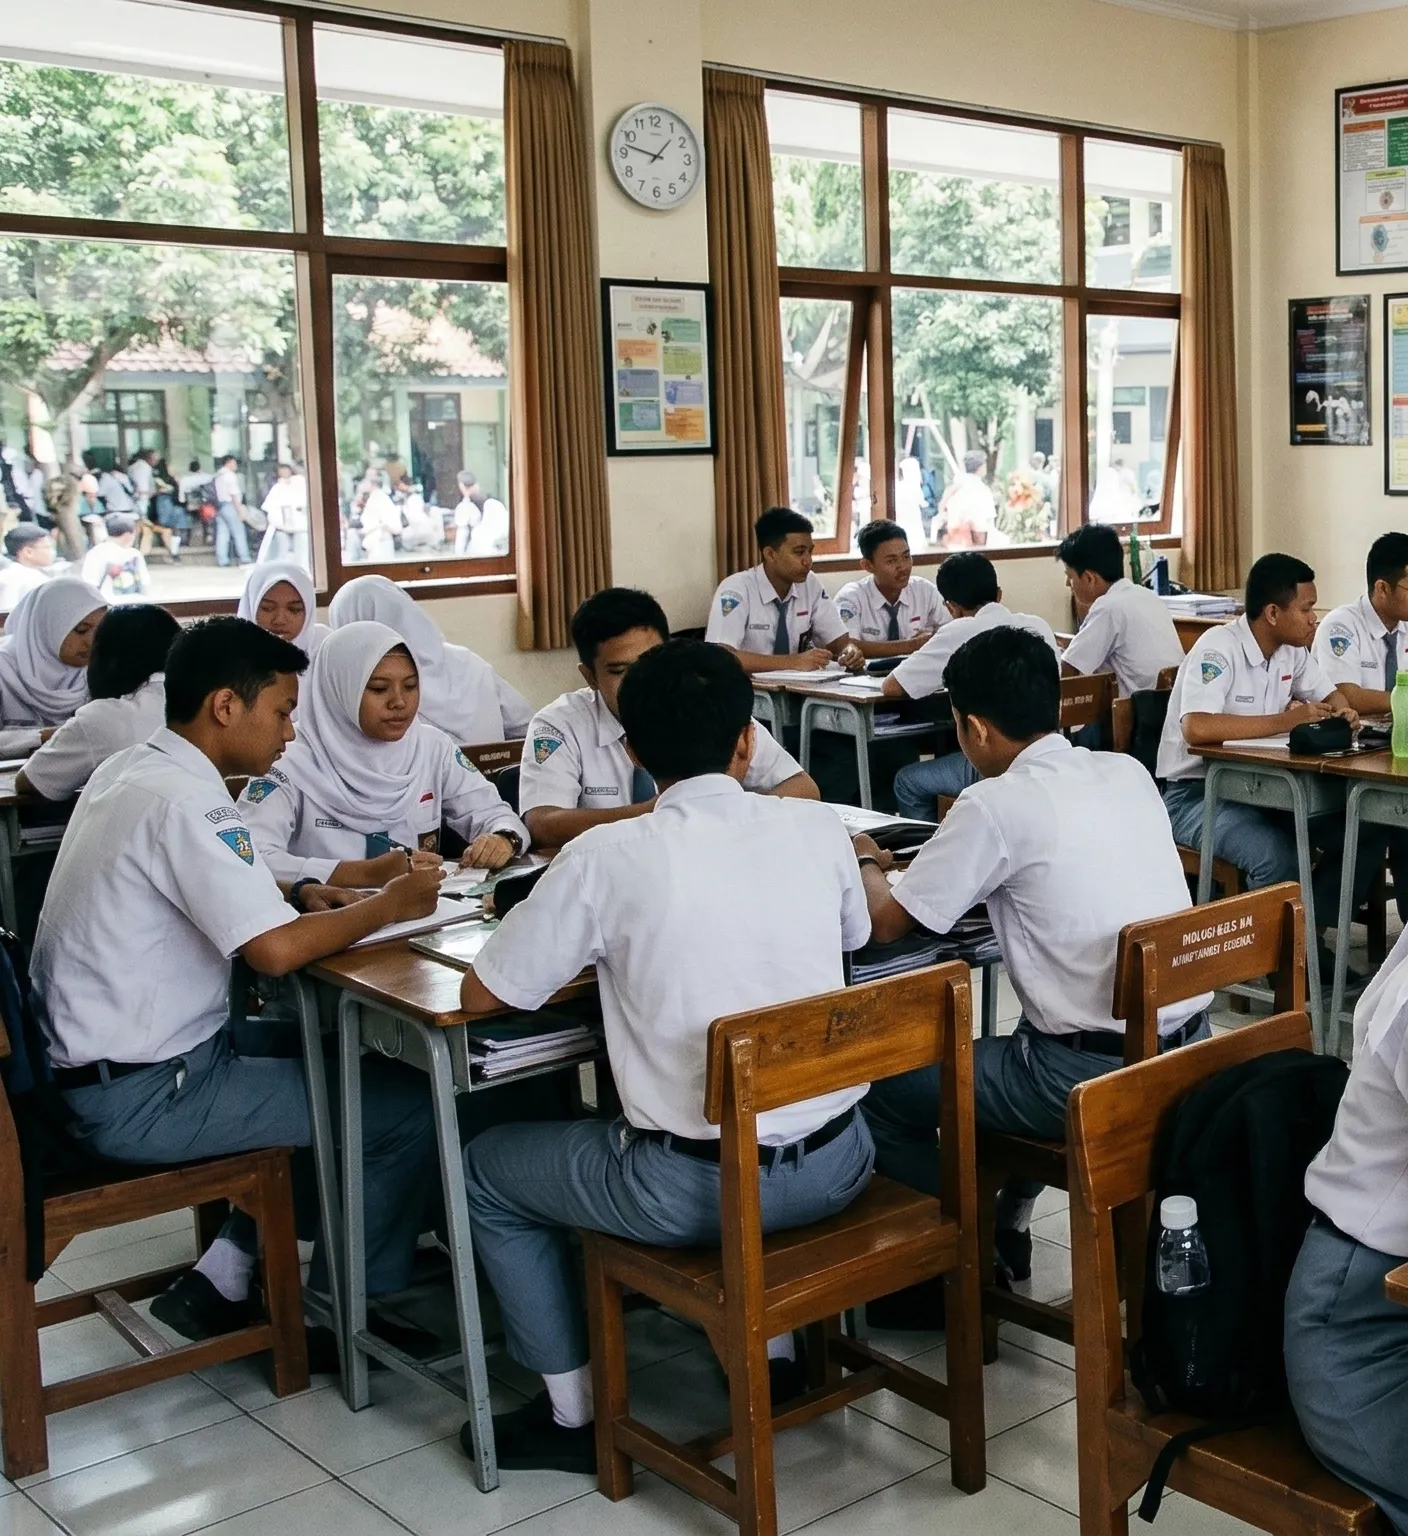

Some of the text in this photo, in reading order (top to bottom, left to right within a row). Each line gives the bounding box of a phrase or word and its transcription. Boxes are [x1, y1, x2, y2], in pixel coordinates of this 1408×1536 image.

[635, 118, 644, 130] 11
[649, 115, 661, 128] 12
[669, 122, 675, 134] 1
[624, 130, 636, 143] 10
[678, 136, 687, 149] 2
[619, 147, 628, 159] 9
[683, 153, 692, 166] 3
[625, 165, 633, 178] 8
[679, 171, 687, 183] 4
[638, 179, 645, 191] 7
[652, 185, 661, 198] 6
[668, 182, 677, 195] 5
